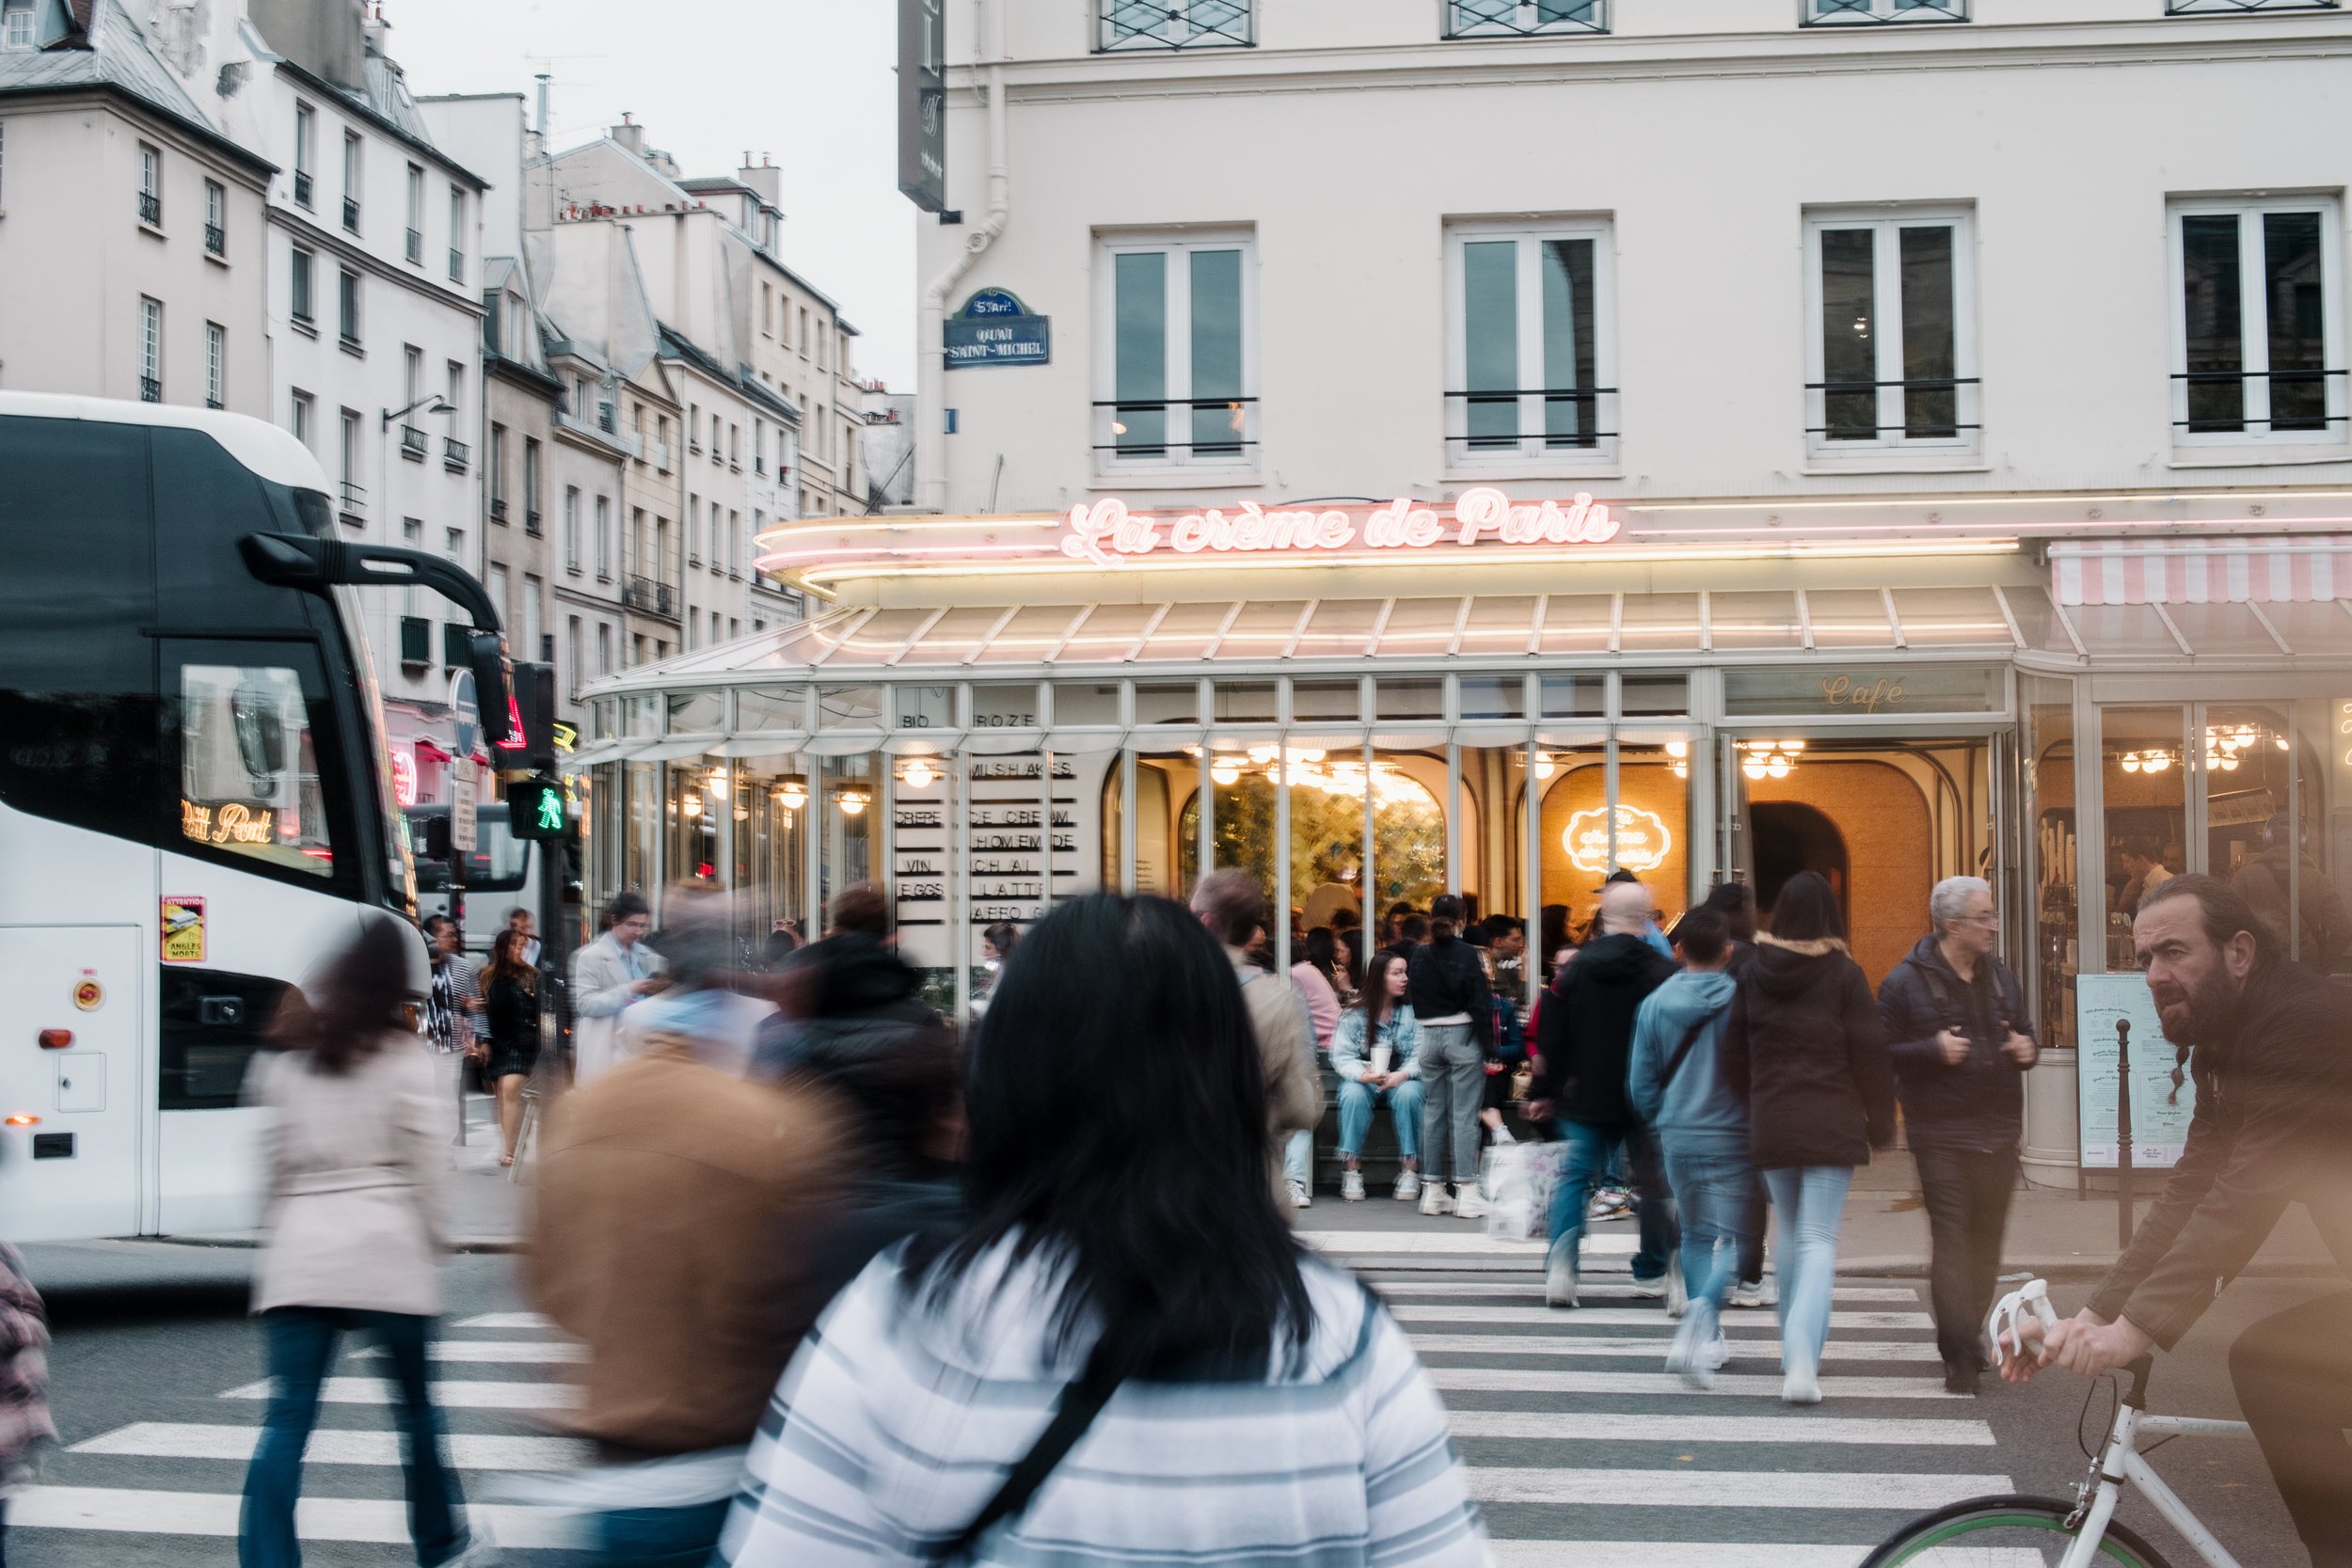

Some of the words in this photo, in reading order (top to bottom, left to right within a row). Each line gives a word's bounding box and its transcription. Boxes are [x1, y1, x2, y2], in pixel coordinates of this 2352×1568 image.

[977, 328, 1013, 342] QUAI
[949, 342, 1044, 358] SAINT-MICHEL
[1060, 498, 1162, 565] La
[1170, 500, 1356, 553] crème
[1364, 498, 1444, 548] de
[1455, 486, 1620, 546] Paris
[1821, 673, 1906, 715] Café
[902, 715, 930, 728] BIO
[975, 714, 1035, 728] ROZE
[212, 803, 272, 844] Pont
[976, 834, 1074, 847] HOMEMDE
[905, 859, 931, 872] VIN
[900, 883, 945, 896] EGGS
